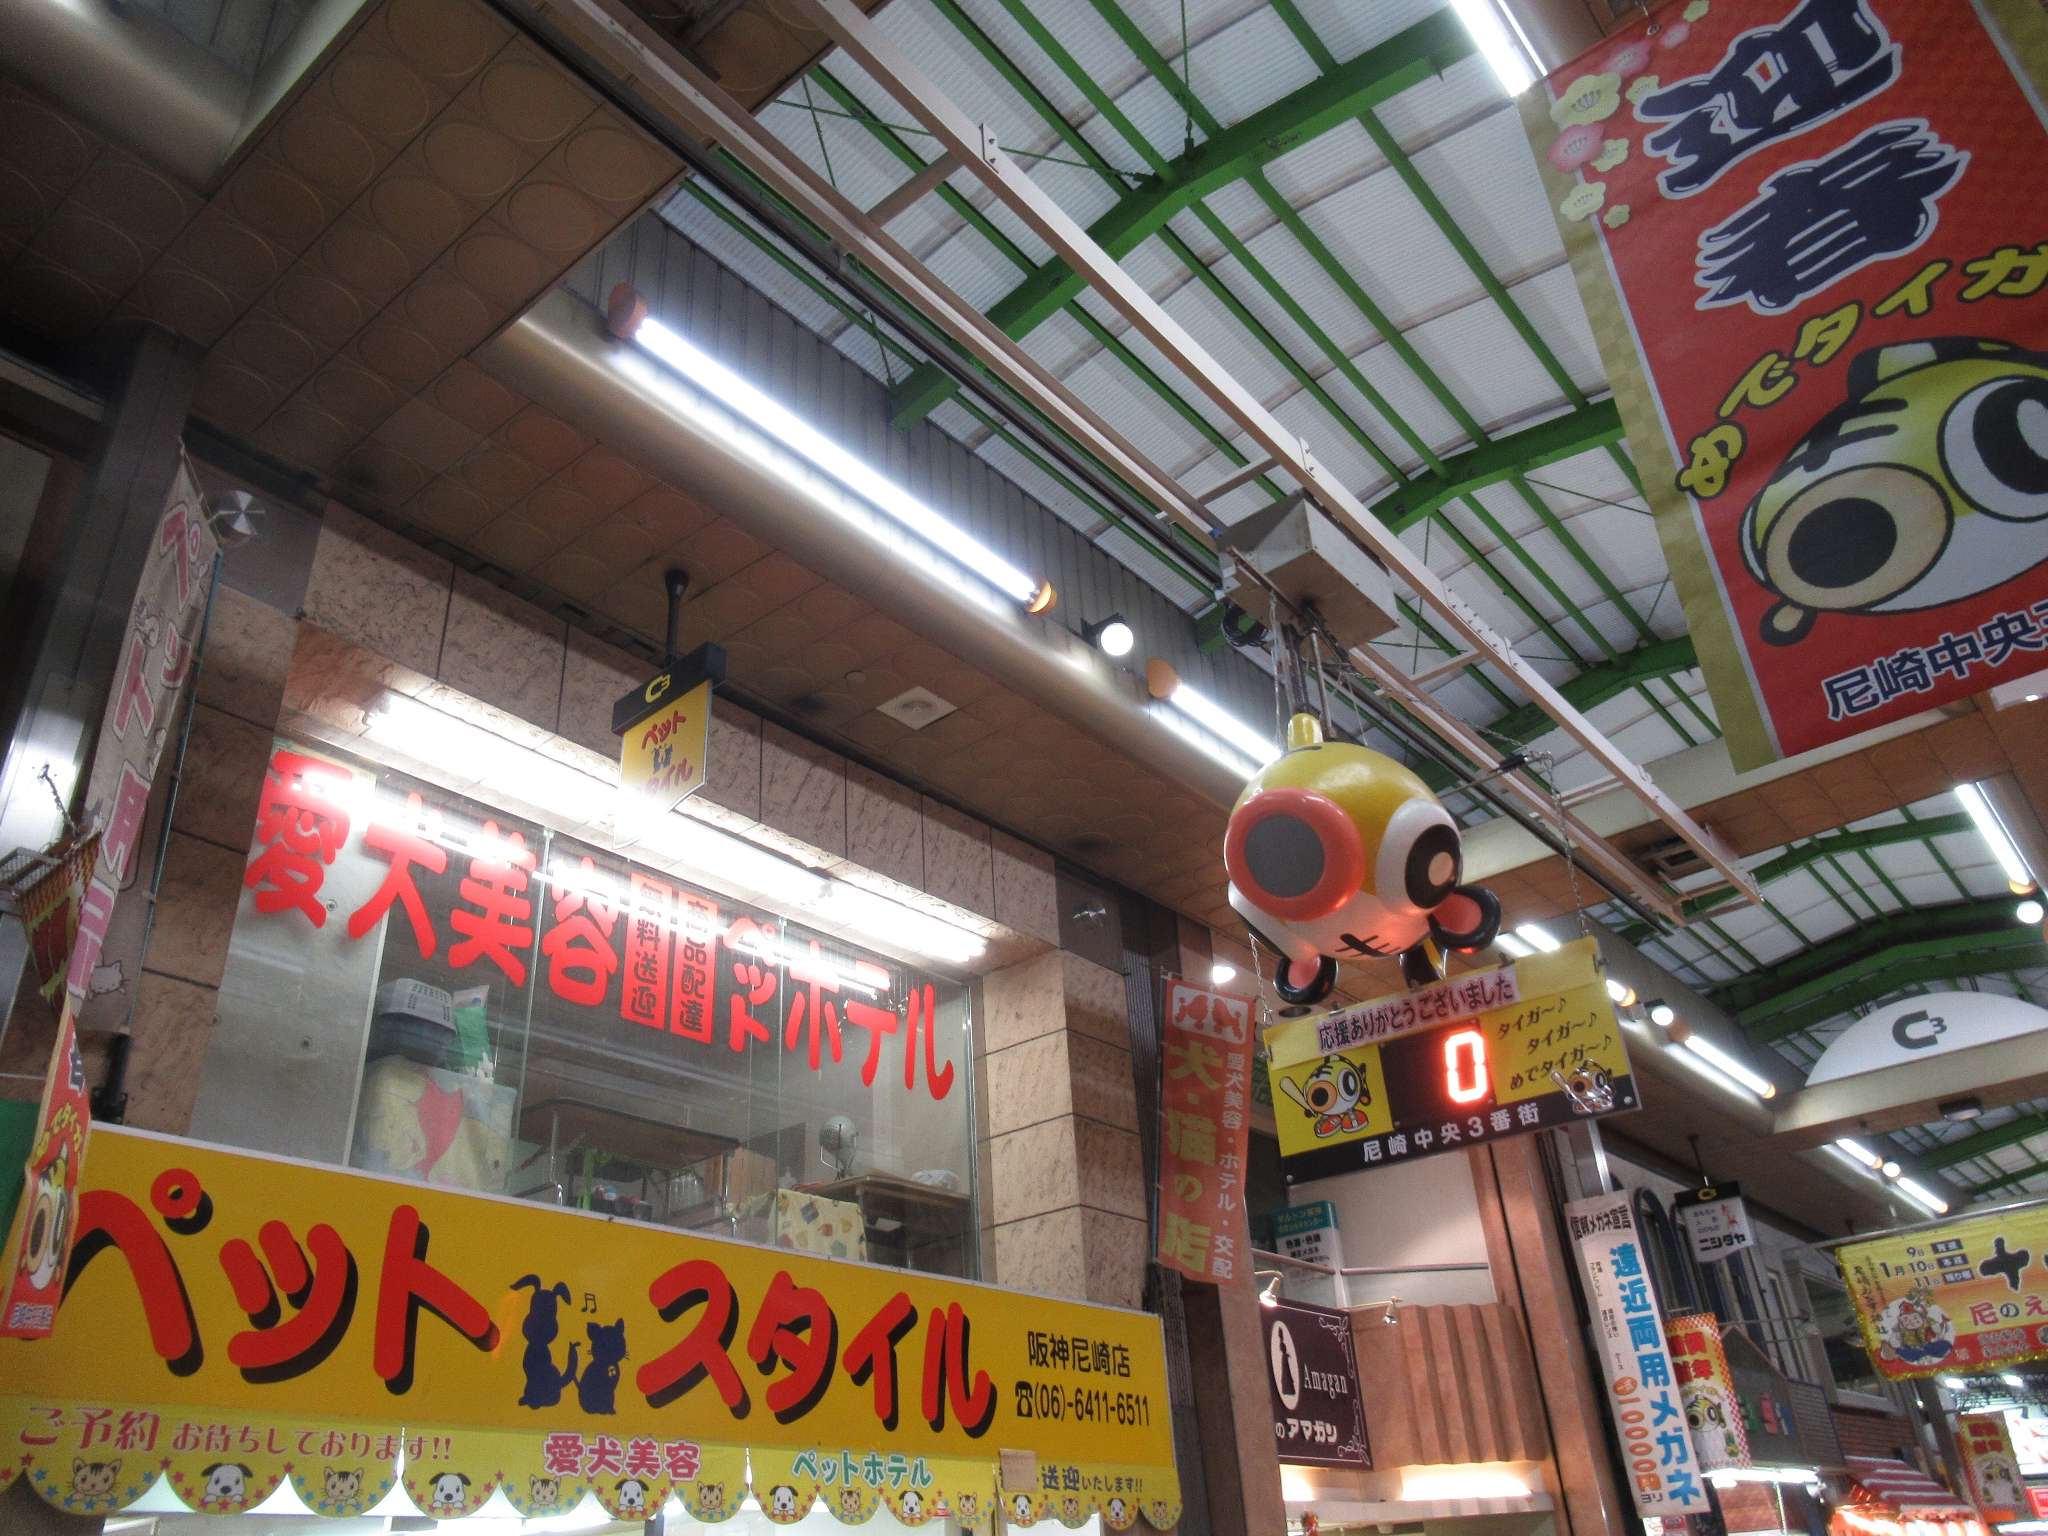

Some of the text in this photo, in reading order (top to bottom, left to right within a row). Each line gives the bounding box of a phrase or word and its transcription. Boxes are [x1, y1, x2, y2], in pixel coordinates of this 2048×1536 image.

[1826, 600, 2048, 722] 尼崎中央
[641, 709, 687, 750] ペット
[645, 757, 693, 797] タイル
[1319, 976, 1514, 1050] 応援ありがとうございました
[1444, 1030, 1488, 1103] 0
[1363, 1103, 1539, 1162] 尼崎中央3番街
[60, 1168, 997, 1438] ペット スタイル
[1027, 1330, 1131, 1378] 阪神尼崎店
[1608, 1243, 1701, 1505] 遠近両用メガネ
[1304, 1363, 1348, 1399] Amagan
[20, 1406, 160, 1451] ご予約
[545, 1433, 700, 1481] 愛犬美容
[794, 1450, 933, 1488] ペットホテル
